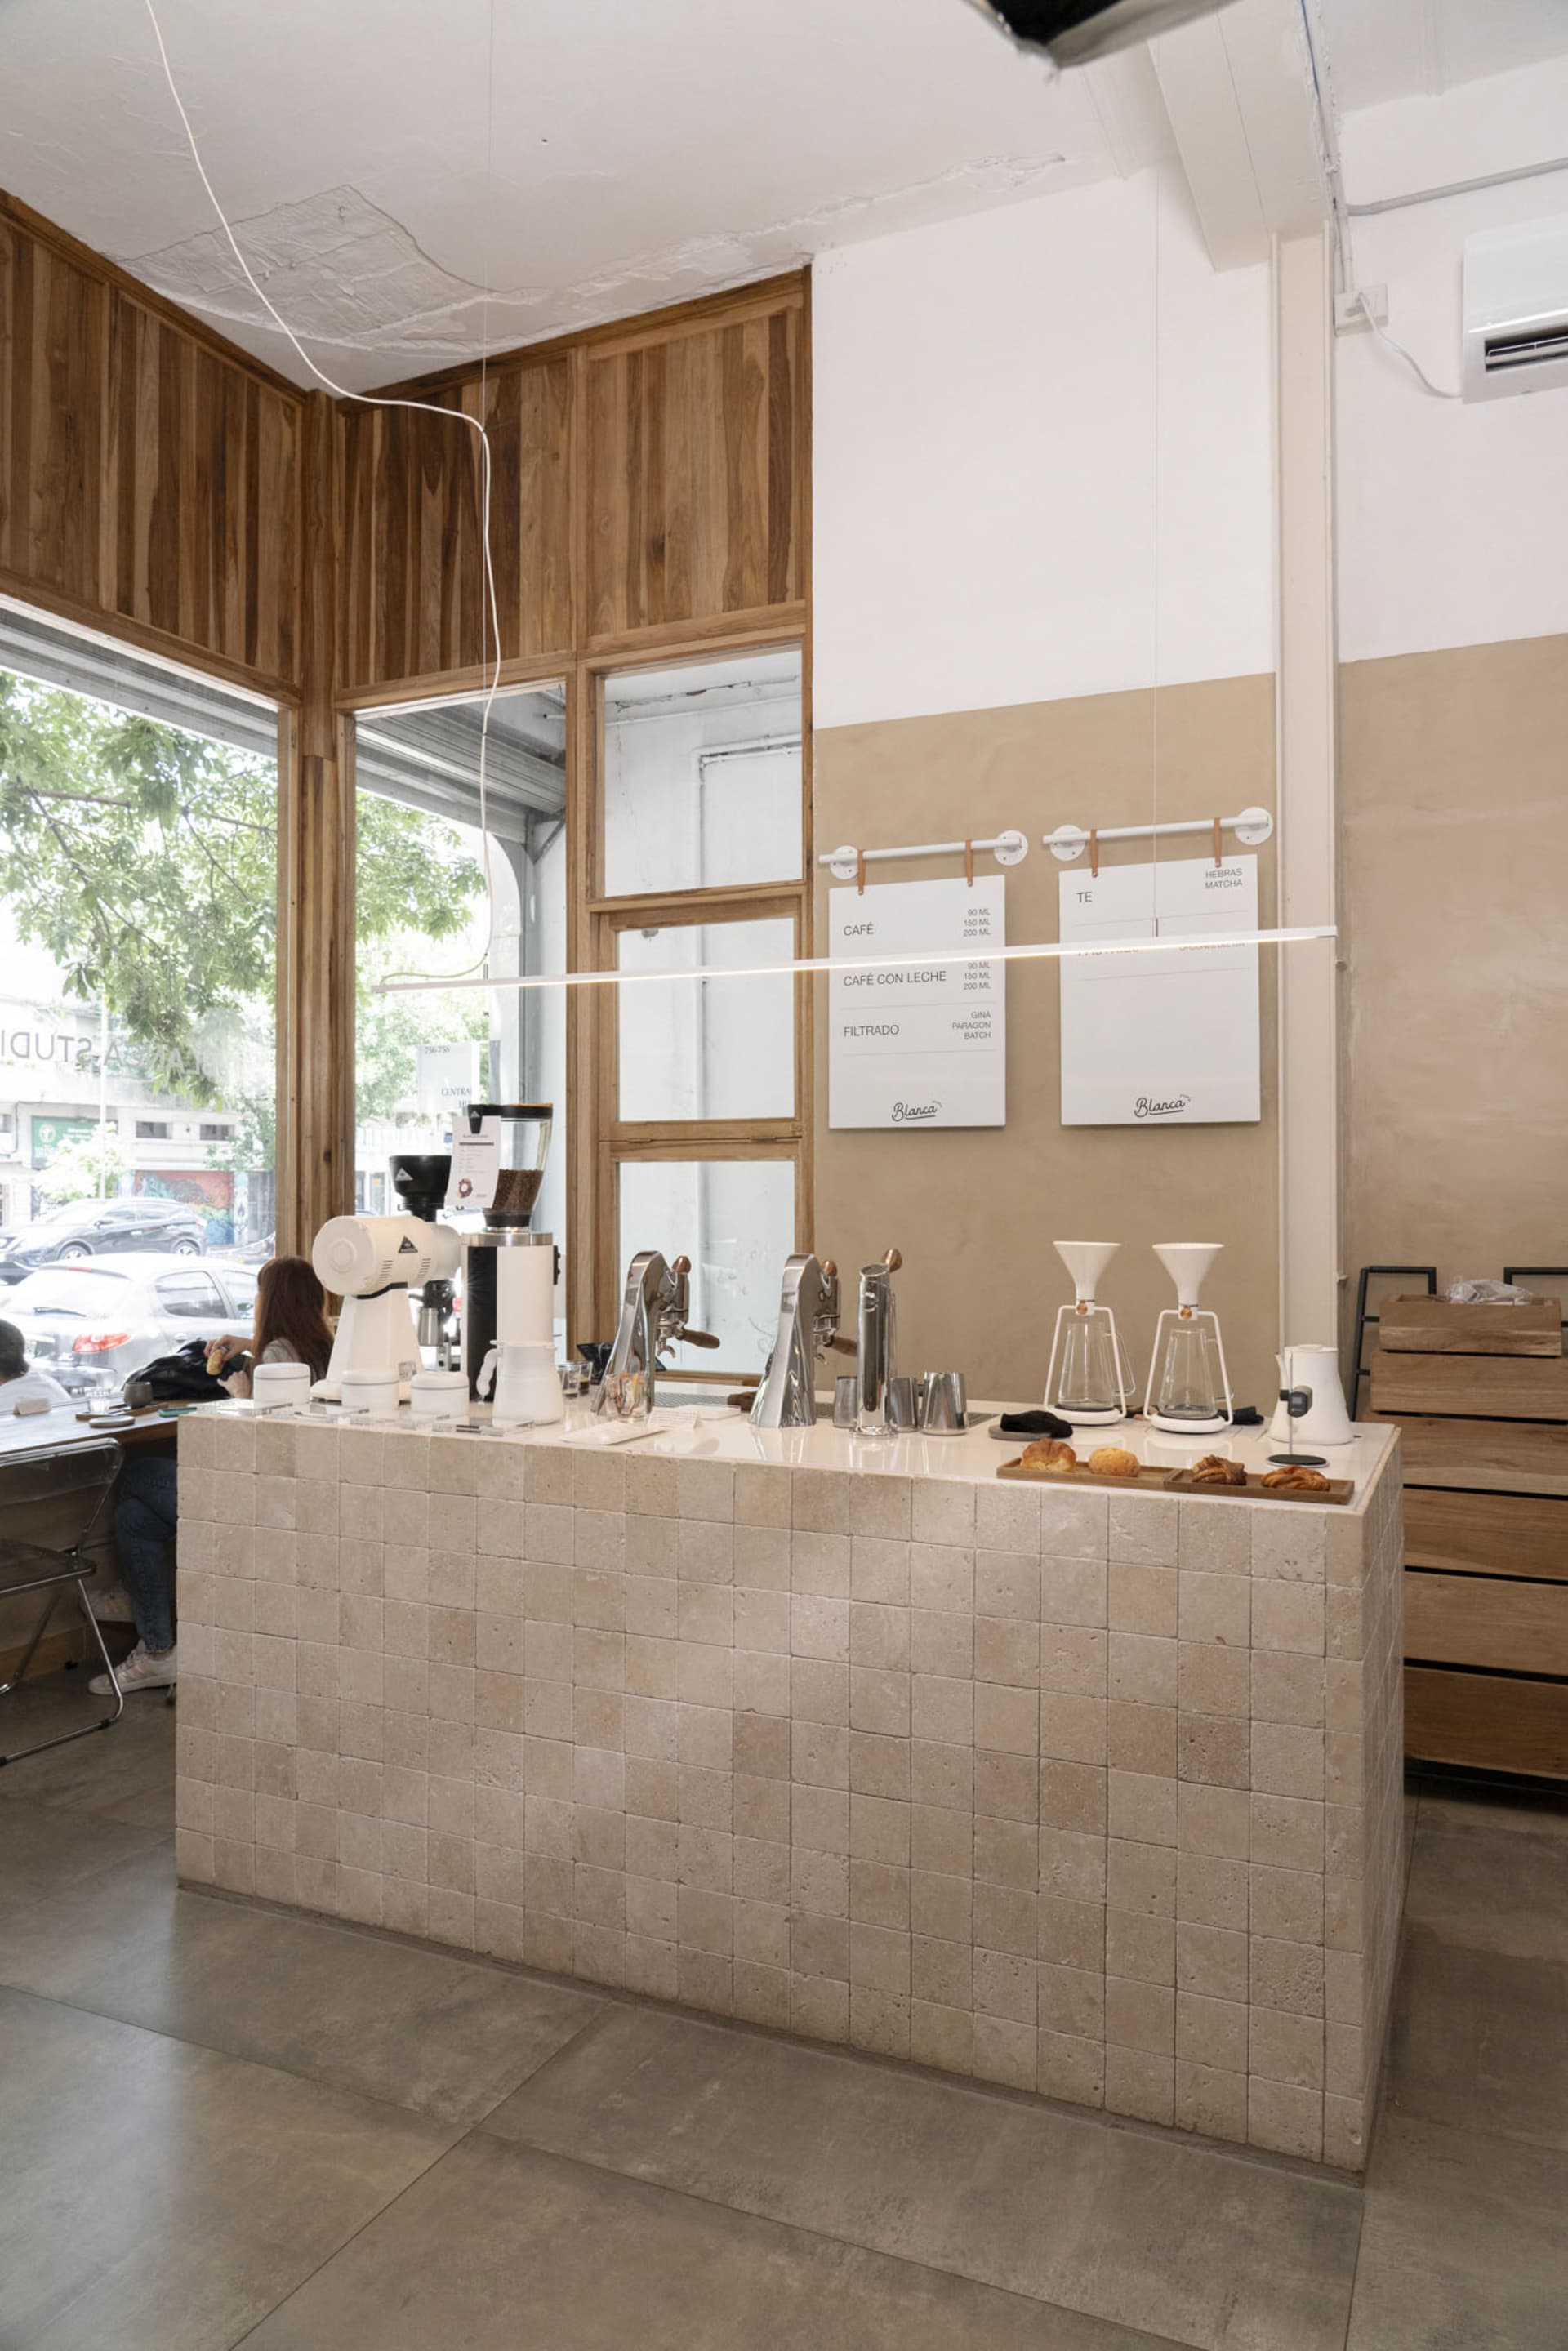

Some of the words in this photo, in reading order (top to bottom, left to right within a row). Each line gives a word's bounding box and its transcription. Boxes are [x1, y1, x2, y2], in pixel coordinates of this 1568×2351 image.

[1205, 868, 1244, 879] HEBRAS
[1204, 879, 1244, 890] MATCHA
[1075, 891, 1094, 904] TE
[967, 909, 978, 917] 90
[978, 908, 991, 916] ML
[963, 919, 978, 927] 150
[843, 921, 875, 937] CAFÉ
[963, 929, 978, 937] 200
[967, 962, 978, 970] 90
[978, 961, 991, 969] ML
[842, 972, 875, 987] CAFÉ
[876, 973, 904, 986] CON
[906, 971, 947, 984] LECHE
[964, 973, 978, 981] 150
[978, 972, 991, 980] ML
[963, 982, 978, 991] 200
[978, 982, 992, 990] ML
[970, 1011, 991, 1020] GINA
[843, 1024, 900, 1038] FILTRADO
[951, 1022, 991, 1031] PARAGON
[964, 1032, 992, 1040] BATCH
[890, 1102, 938, 1123] Blanca
[1133, 1097, 1186, 1119] Blanca
